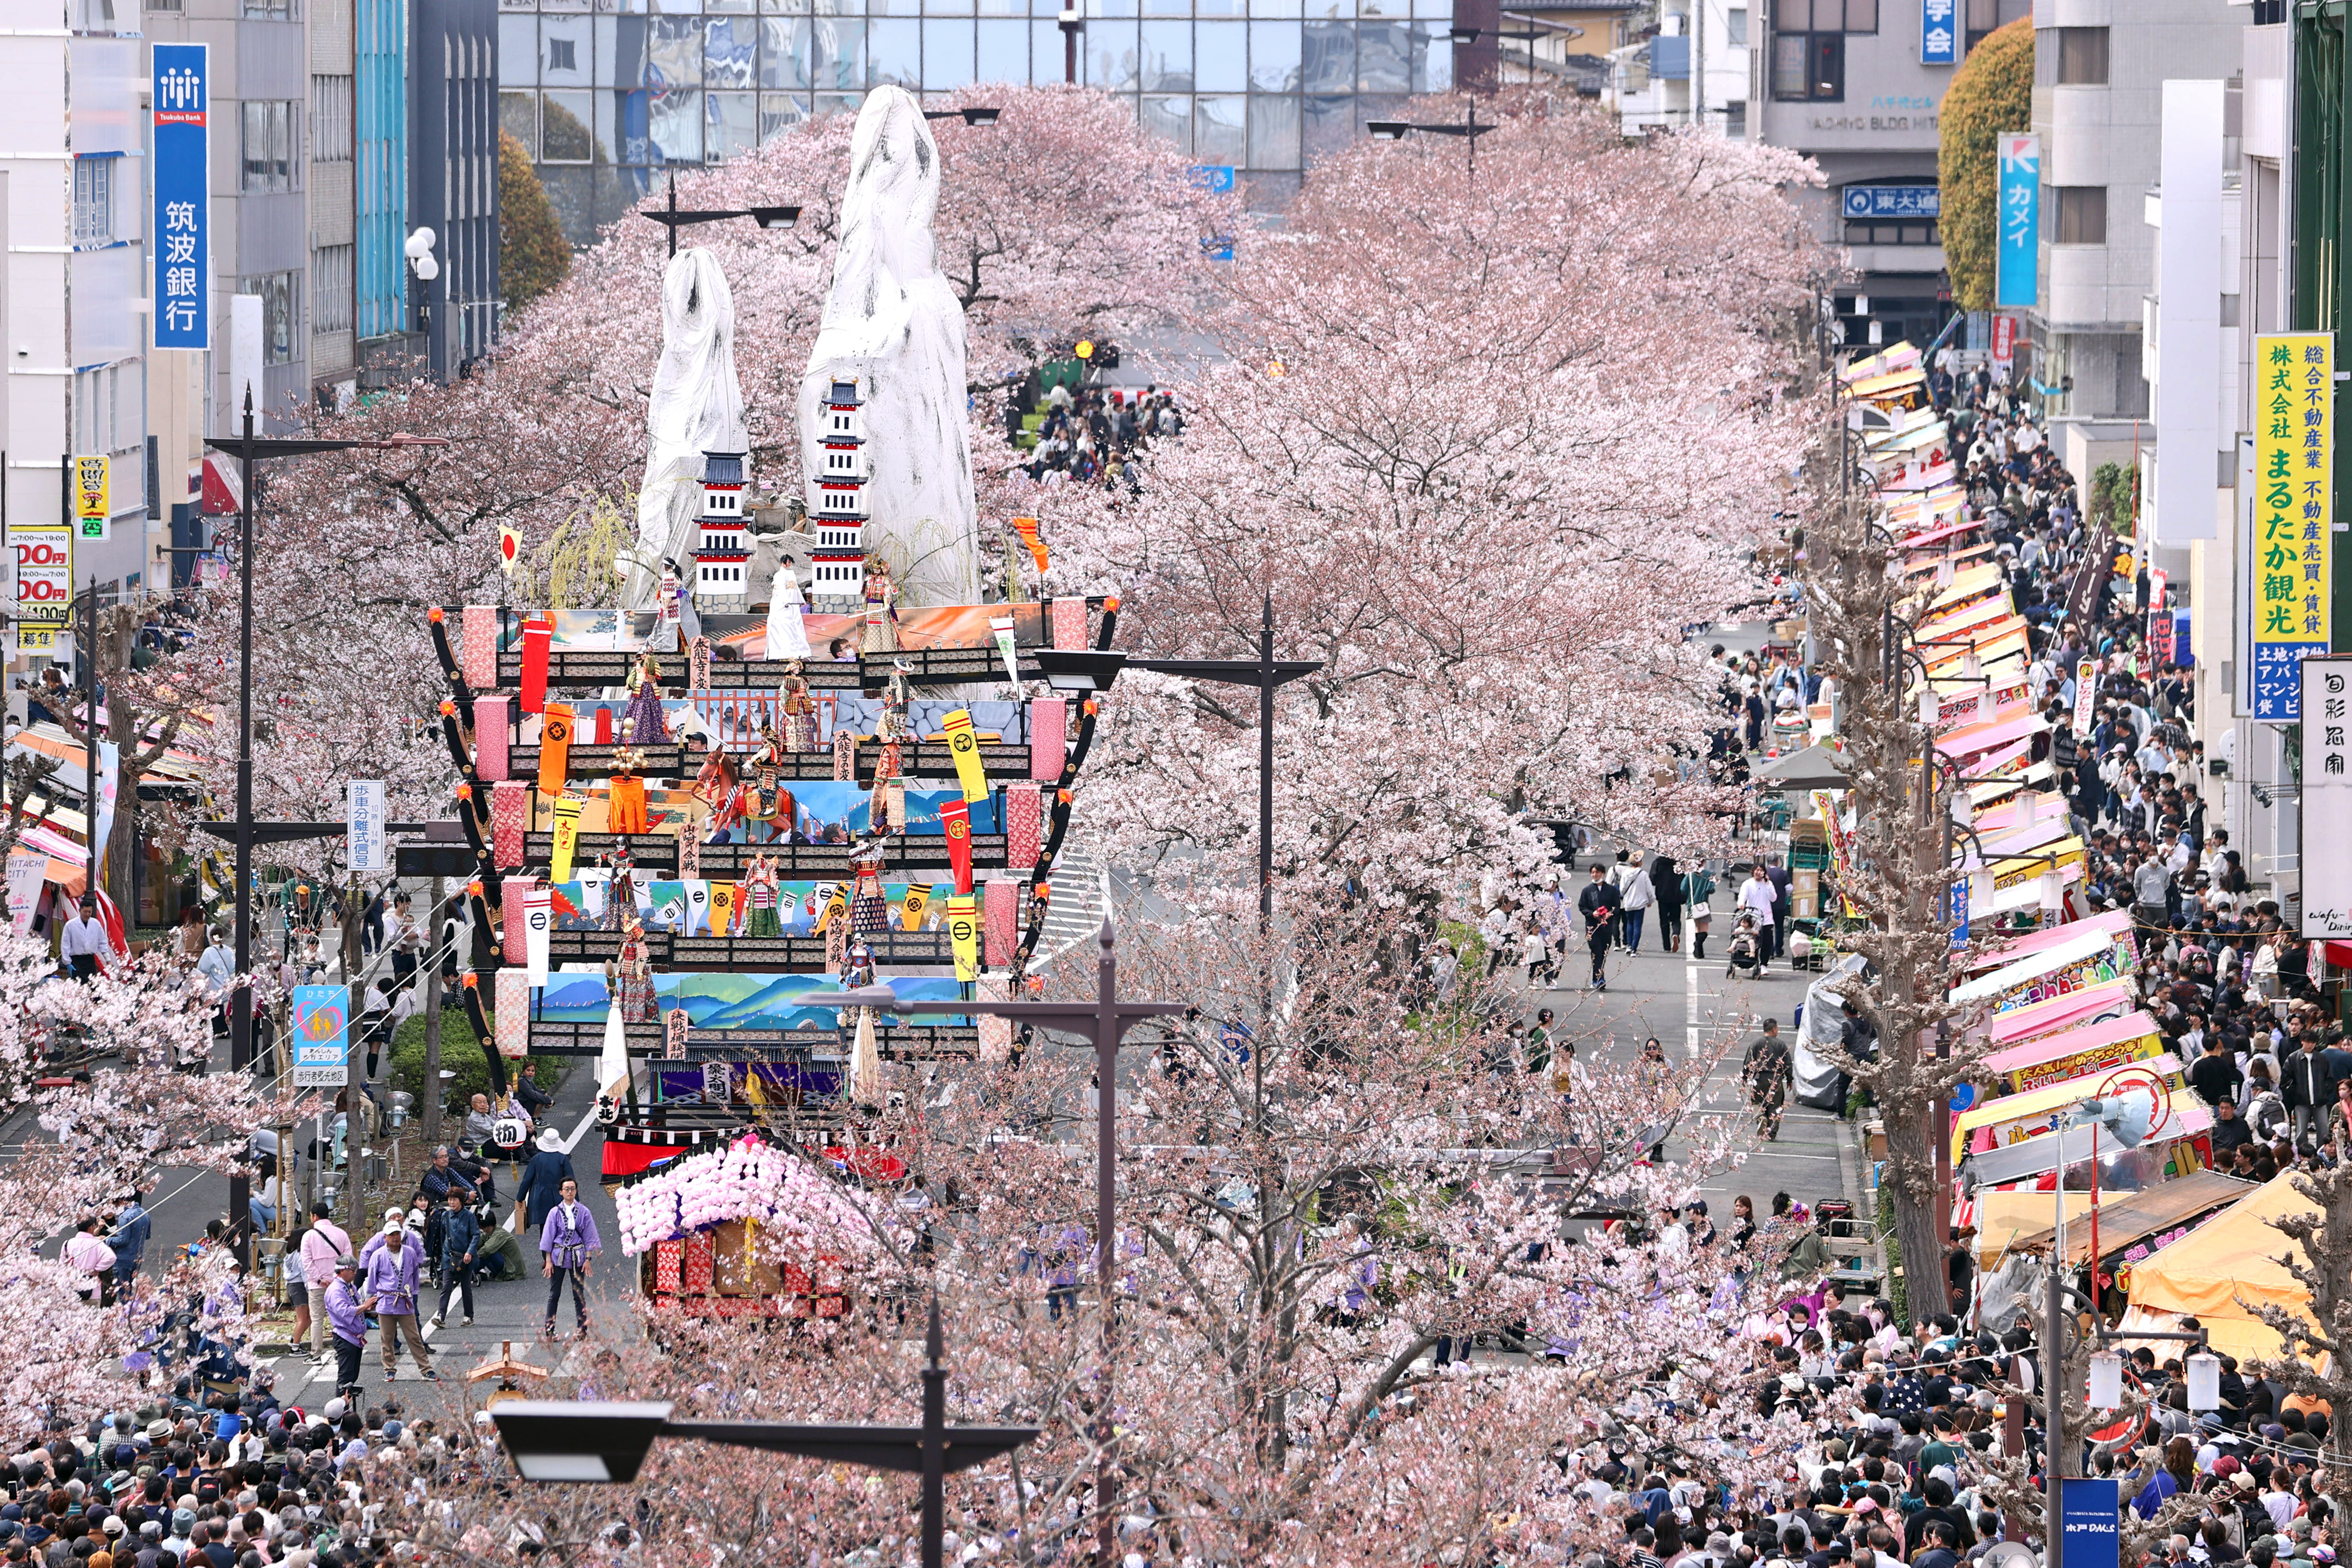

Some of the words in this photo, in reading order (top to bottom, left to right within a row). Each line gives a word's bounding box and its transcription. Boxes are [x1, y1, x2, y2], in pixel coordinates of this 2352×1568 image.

[1870, 96, 1934, 109] 八千代ビル
[1870, 117, 1907, 130] BLDG
[2008, 183, 2031, 249] カメイ
[165, 201, 197, 332] 筑波銀行
[2267, 345, 2293, 440] 株式会社
[2302, 345, 2325, 470] 総合不動産業
[81, 459, 105, 491] 時間貸
[82, 517, 102, 537] 空
[2264, 449, 2298, 635] まるたか観光
[2301, 480, 2323, 635] 不動産売買・賃貸
[693, 638, 709, 690] 本能寺の変
[2325, 673, 2346, 776] 旬彩忍家
[837, 731, 852, 781] 本能寺の変
[354, 785, 369, 867] 歩車分離式信号
[681, 824, 697, 872] 山崎の合戦
[8, 860, 45, 868] HITACHI
[828, 918, 843, 964] 山崎の合戦
[298, 1071, 344, 1082] 歩行者優先地区
[2124, 1244, 2150, 1263] 元祖
